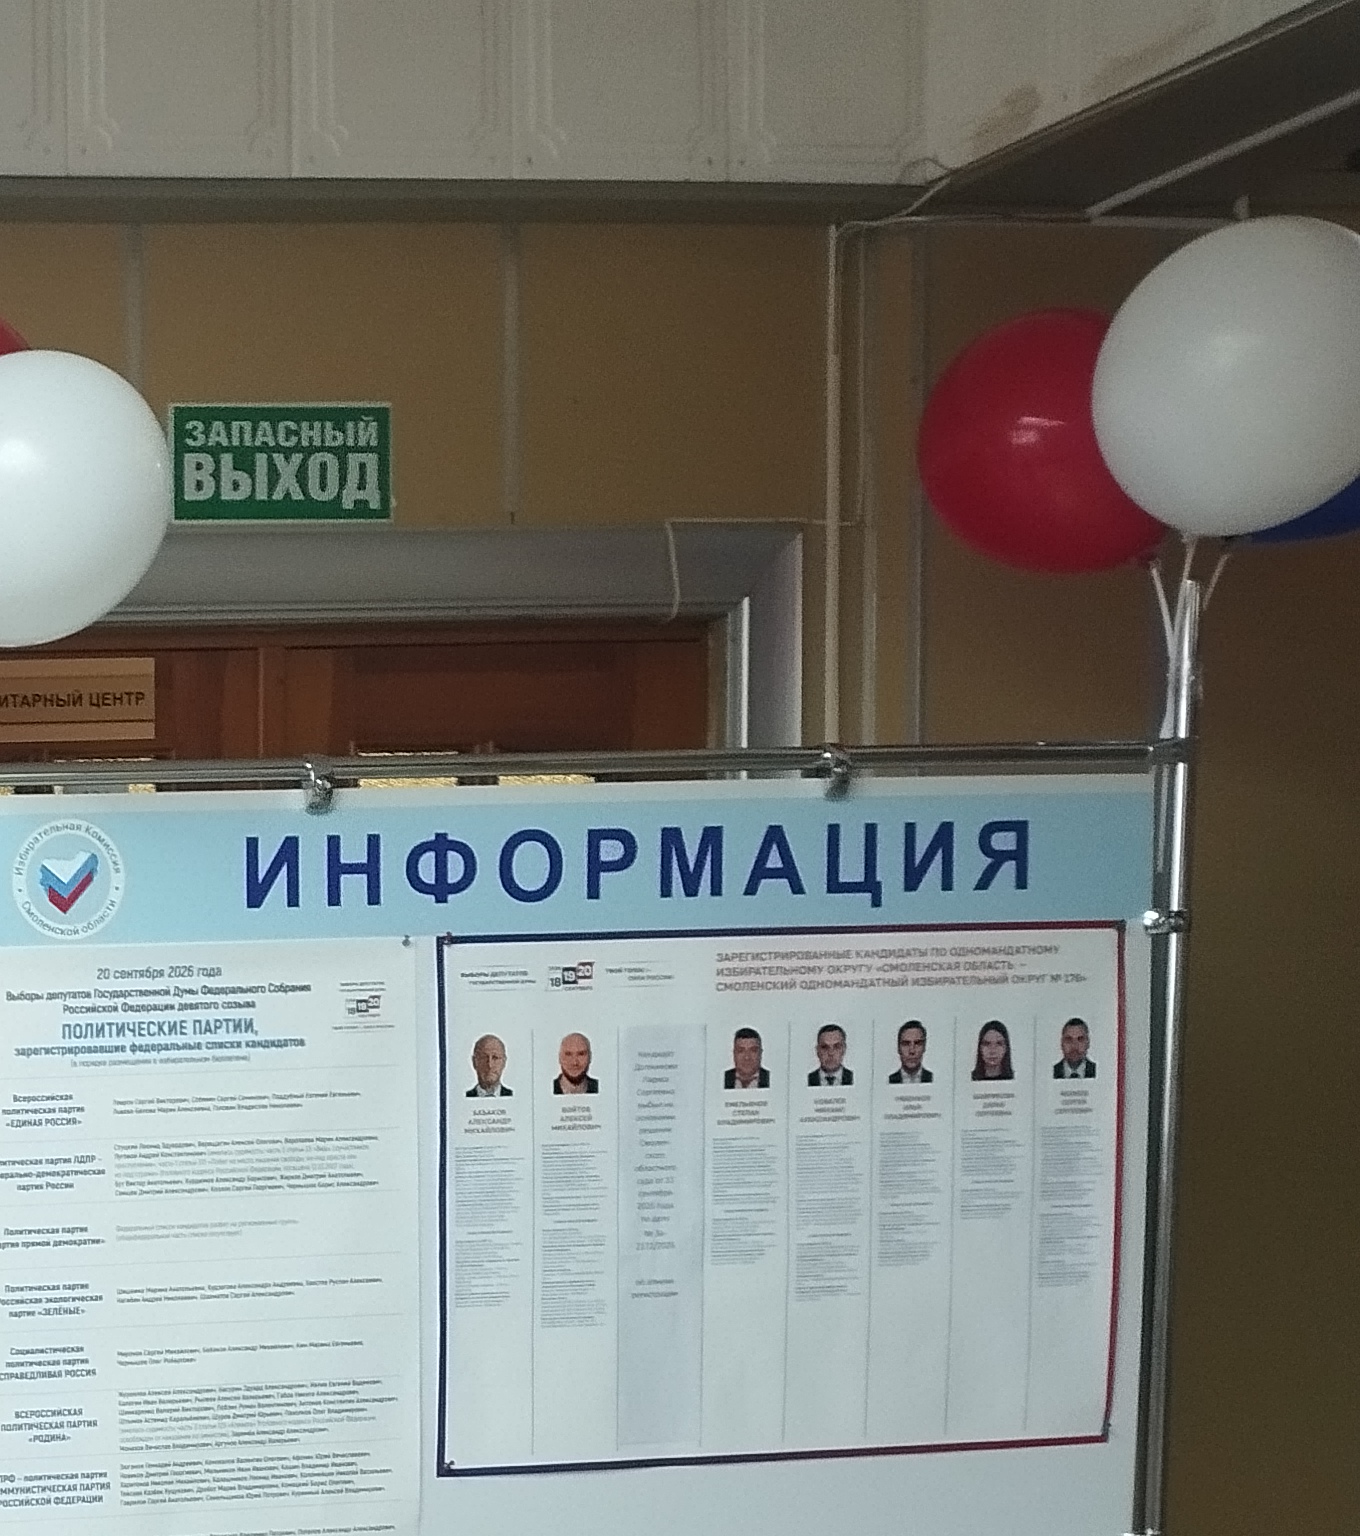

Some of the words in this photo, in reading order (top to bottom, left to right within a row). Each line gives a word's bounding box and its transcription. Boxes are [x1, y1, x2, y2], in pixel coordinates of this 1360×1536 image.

[184, 414, 379, 448] ЗАПАСНЫЙ
[183, 451, 381, 510] ВЫХОД
[89, 691, 146, 709] ЦЕНТР
[14, 822, 82, 877] Избирательная
[84, 824, 122, 875] Комиссия
[244, 819, 1031, 908] ИНФОРМАЦИЯ
[21, 900, 80, 937] Смоленской
[81, 898, 118, 934] области
[716, 949, 853, 962] ЗАРЕГИСТРИРОВАННЫЕ
[854, 947, 929, 959] КАНДИДАТЫ
[930, 947, 948, 957] ПО
[949, 945, 1060, 957] ОДНОМАНДАТНОМУ
[97, 968, 110, 980] 20
[113, 966, 164, 981] сентября
[168, 966, 194, 978] 2026
[197, 965, 223, 979] года
[715, 964, 824, 977] ИЗБИРАТЕЛЬНОМУ
[827, 963, 873, 975] ОКРУГУ
[963, 960, 1014, 971] ОБЛАСТЬ
[715, 979, 797, 992] СМОЛЕНСКИЙ
[799, 975, 909, 990] ОДНОМАНДАТНЫЙ
[911, 974, 1009, 987] ИЗБИРАТЕЛЬНЫЙ
[1011, 973, 1046, 985] ОКРУГ
[5, 991, 44, 1002] Выборы
[46, 990, 91, 1002] депутатов
[94, 985, 172, 1001] Государственной
[173, 985, 199, 998] Думы
[200, 983, 266, 996] Федерального
[268, 982, 312, 994] Собрания
[63, 1001, 119, 1015] Российской
[121, 1000, 176, 1014] Федерации
[177, 1000, 219, 1012] девятого
[221, 999, 256, 1010] созыва
[62, 1019, 188, 1040] ПОЛИТИЧЕСКИЕ
[192, 1017, 259, 1037] ПАРТИИ,
[14, 1043, 127, 1058] зарегистрировавшие
[129, 1040, 203, 1055] федеральные
[205, 1039, 242, 1051] списки
[245, 1037, 306, 1050] кандидатов
[12, 1093, 74, 1103] Всероссийская
[2, 1106, 57, 1116] политическая
[58, 1105, 85, 1116] партия
[5, 1117, 43, 1128] «ЕДИНАЯ
[45, 1117, 82, 1127] РОССИЯ»
[45, 1157, 72, 1168] партия
[73, 1154, 96, 1165] ЛДПР
[17, 1183, 44, 1193] партия
[46, 1181, 75, 1191] России
[4, 1226, 59, 1237] Политическая
[61, 1225, 88, 1236] партия
[21, 1238, 51, 1249] прямой
[4, 1284, 60, 1294] Политическая
[62, 1282, 89, 1293] партия
[45, 1294, 103, 1305] экологическая
[8, 1308, 36, 1319] партия
[10, 1345, 84, 1356] Социалистическая
[5, 1358, 60, 1369] политическая
[61, 1358, 89, 1368] партия
[64, 1369, 97, 1379] РОССИЯ
[14, 1407, 83, 1420] ВСЕРОССИЙСКАЯ
[0, 1421, 65, 1432] ПОЛИТИЧЕСКАЯ
[66, 1419, 98, 1430] ПАРТИЯ
[28, 1433, 71, 1444] «РОДИНА»
[23, 1472, 79, 1483] политическая
[81, 1470, 108, 1481] партия
[79, 1481, 111, 1493] ПАРТИЯ
[53, 1494, 104, 1506] ФЕДЕРАЦИИ
